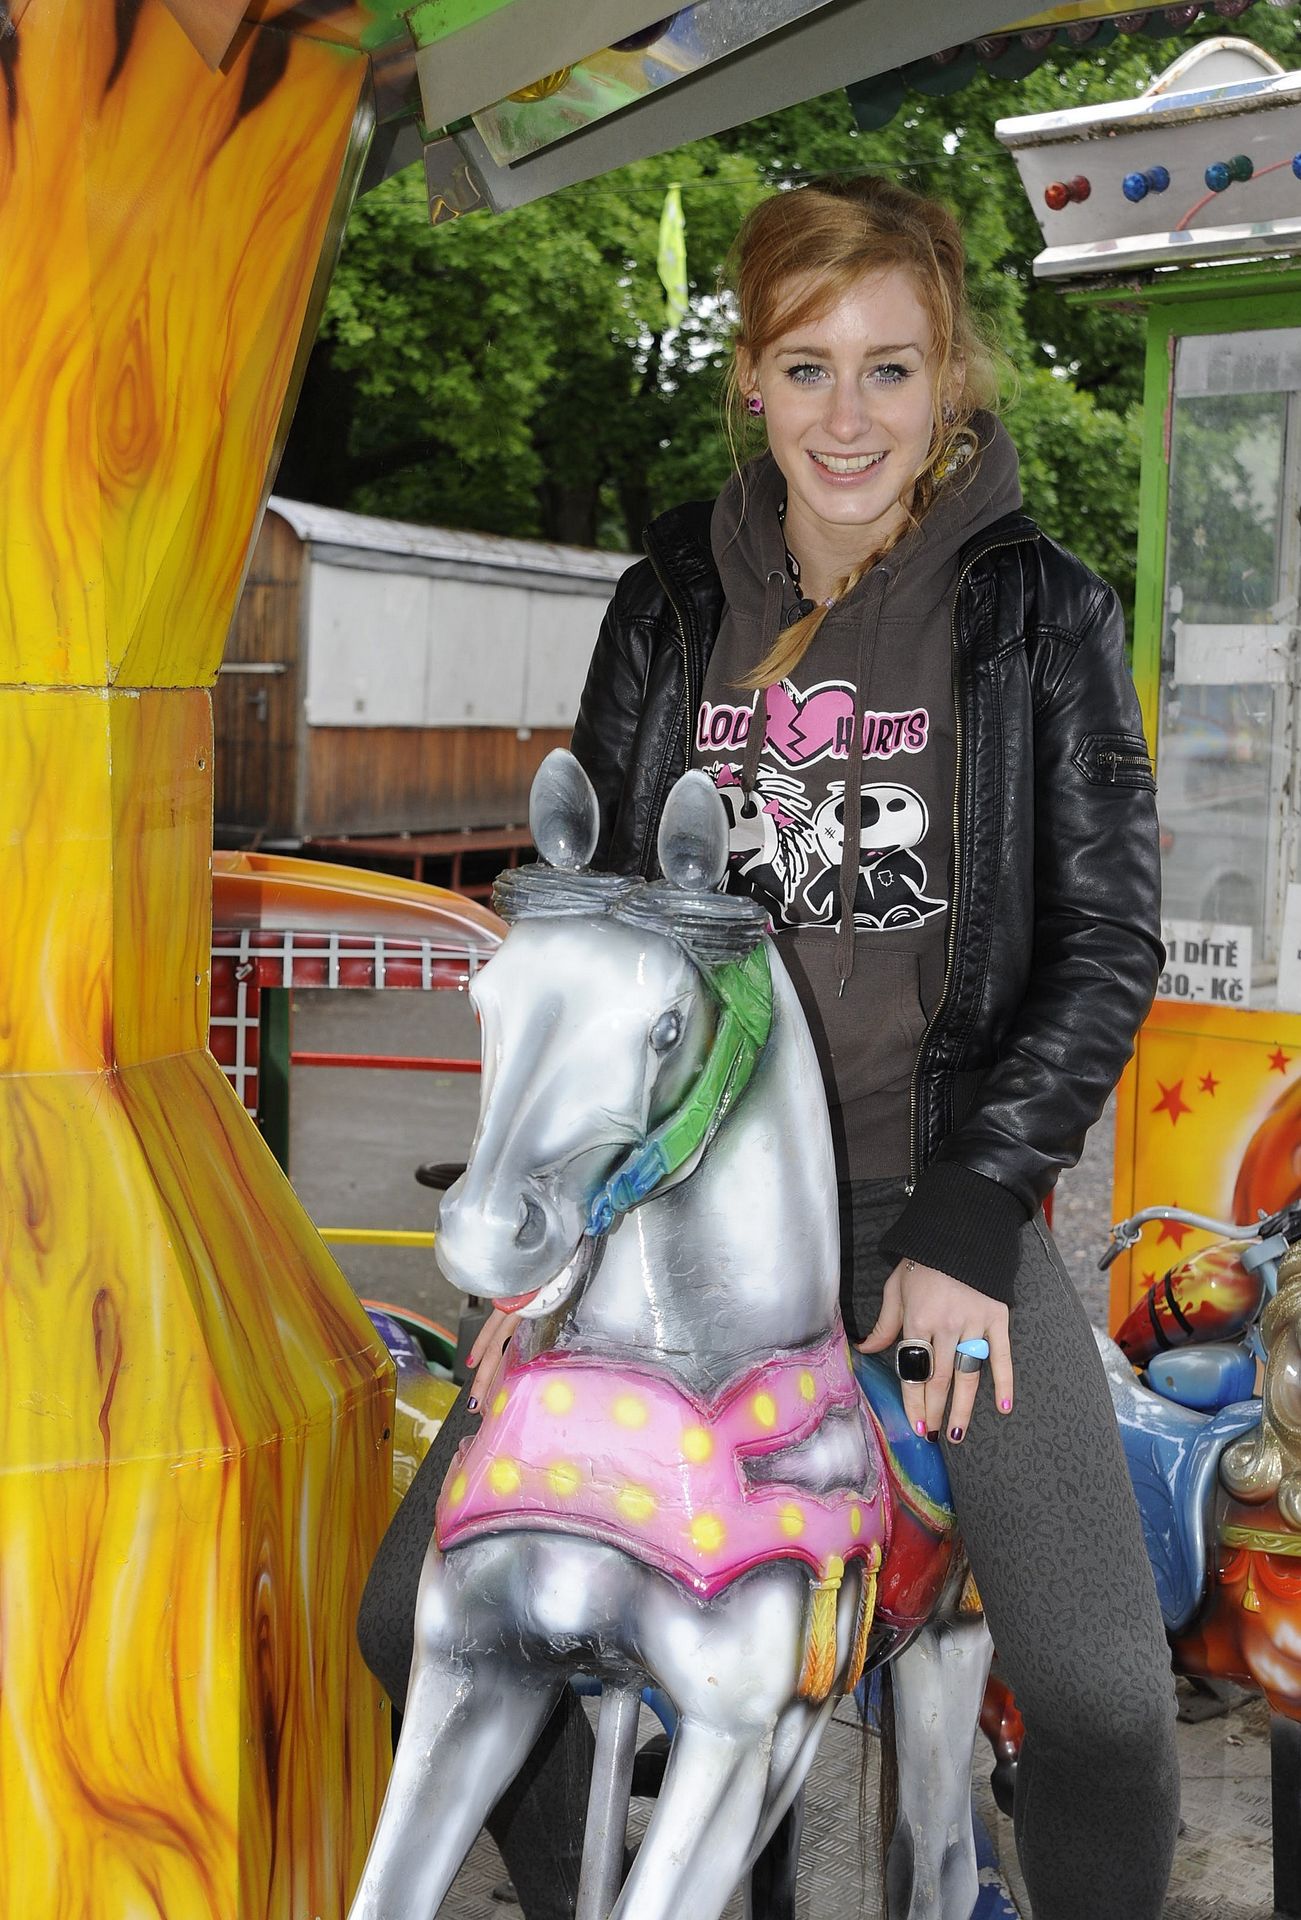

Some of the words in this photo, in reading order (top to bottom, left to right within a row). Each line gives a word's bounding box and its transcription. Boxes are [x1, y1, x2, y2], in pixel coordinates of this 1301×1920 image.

[698, 706, 771, 749] LOV
[834, 711, 927, 755] HURTS
[1184, 938, 1238, 968] DÍTĚ
[1211, 977, 1243, 1002] KČ
